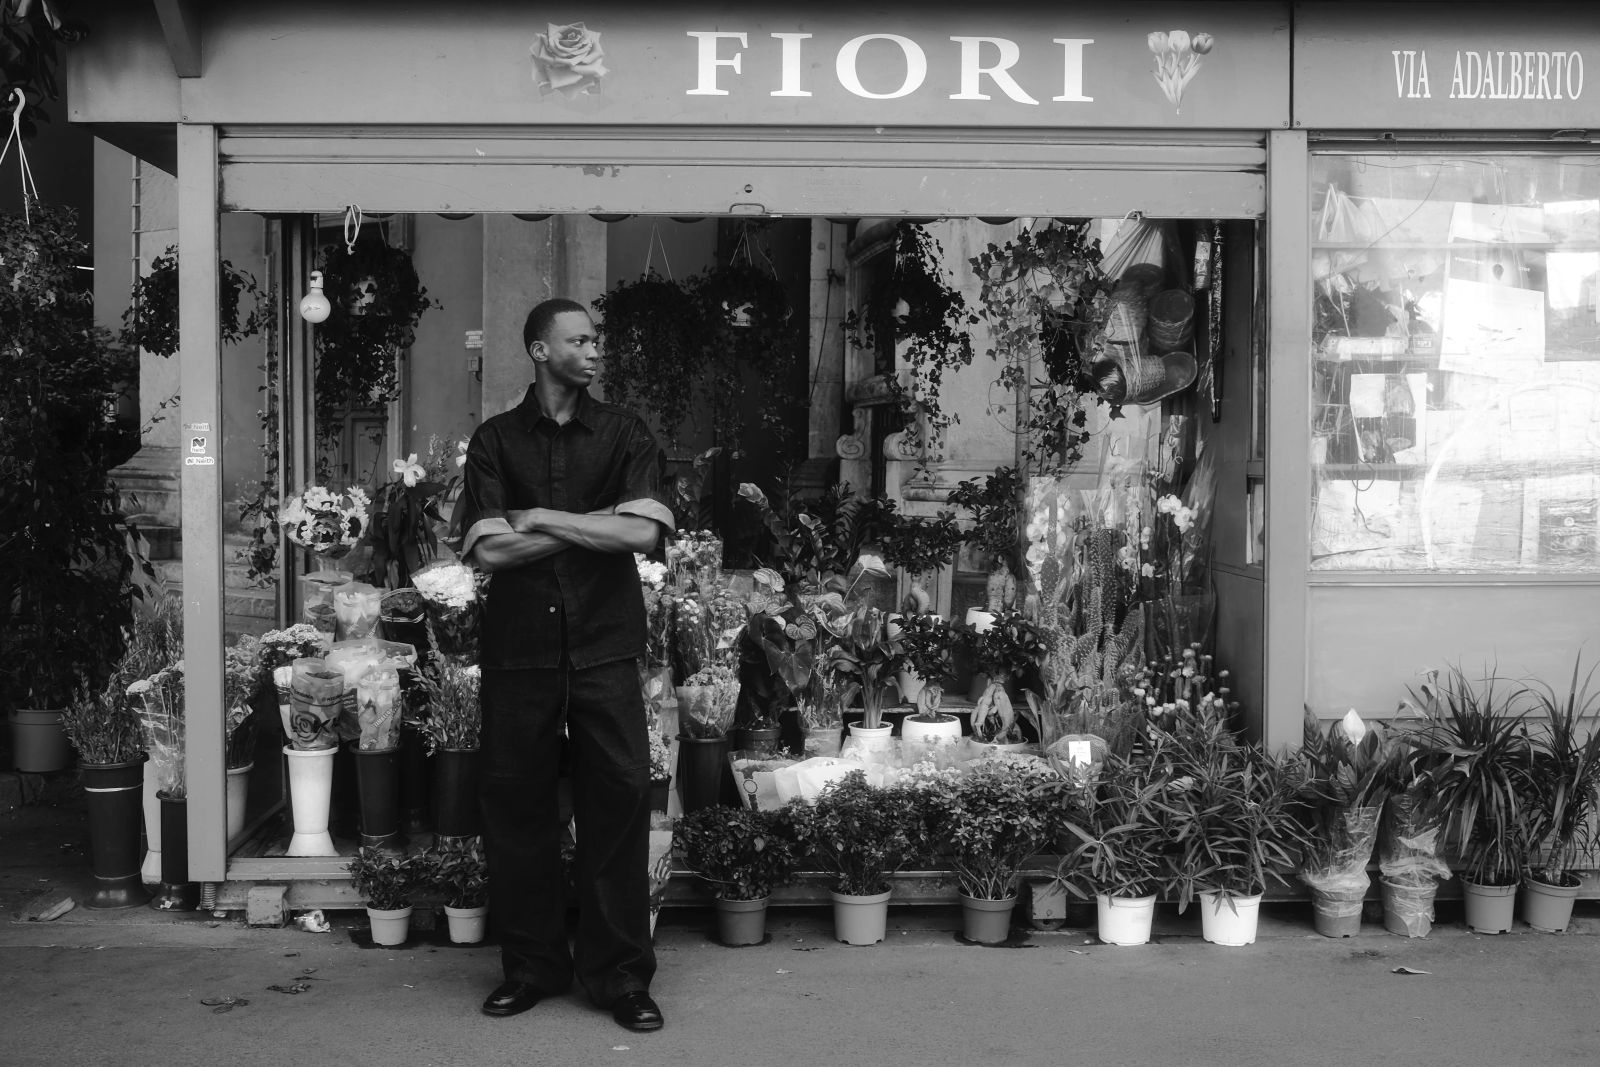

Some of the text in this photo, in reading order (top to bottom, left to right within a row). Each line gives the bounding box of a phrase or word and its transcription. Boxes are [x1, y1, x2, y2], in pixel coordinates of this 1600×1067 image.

[686, 31, 1095, 105] FIORI
[1391, 50, 1584, 100] VIA ADALBERTO
